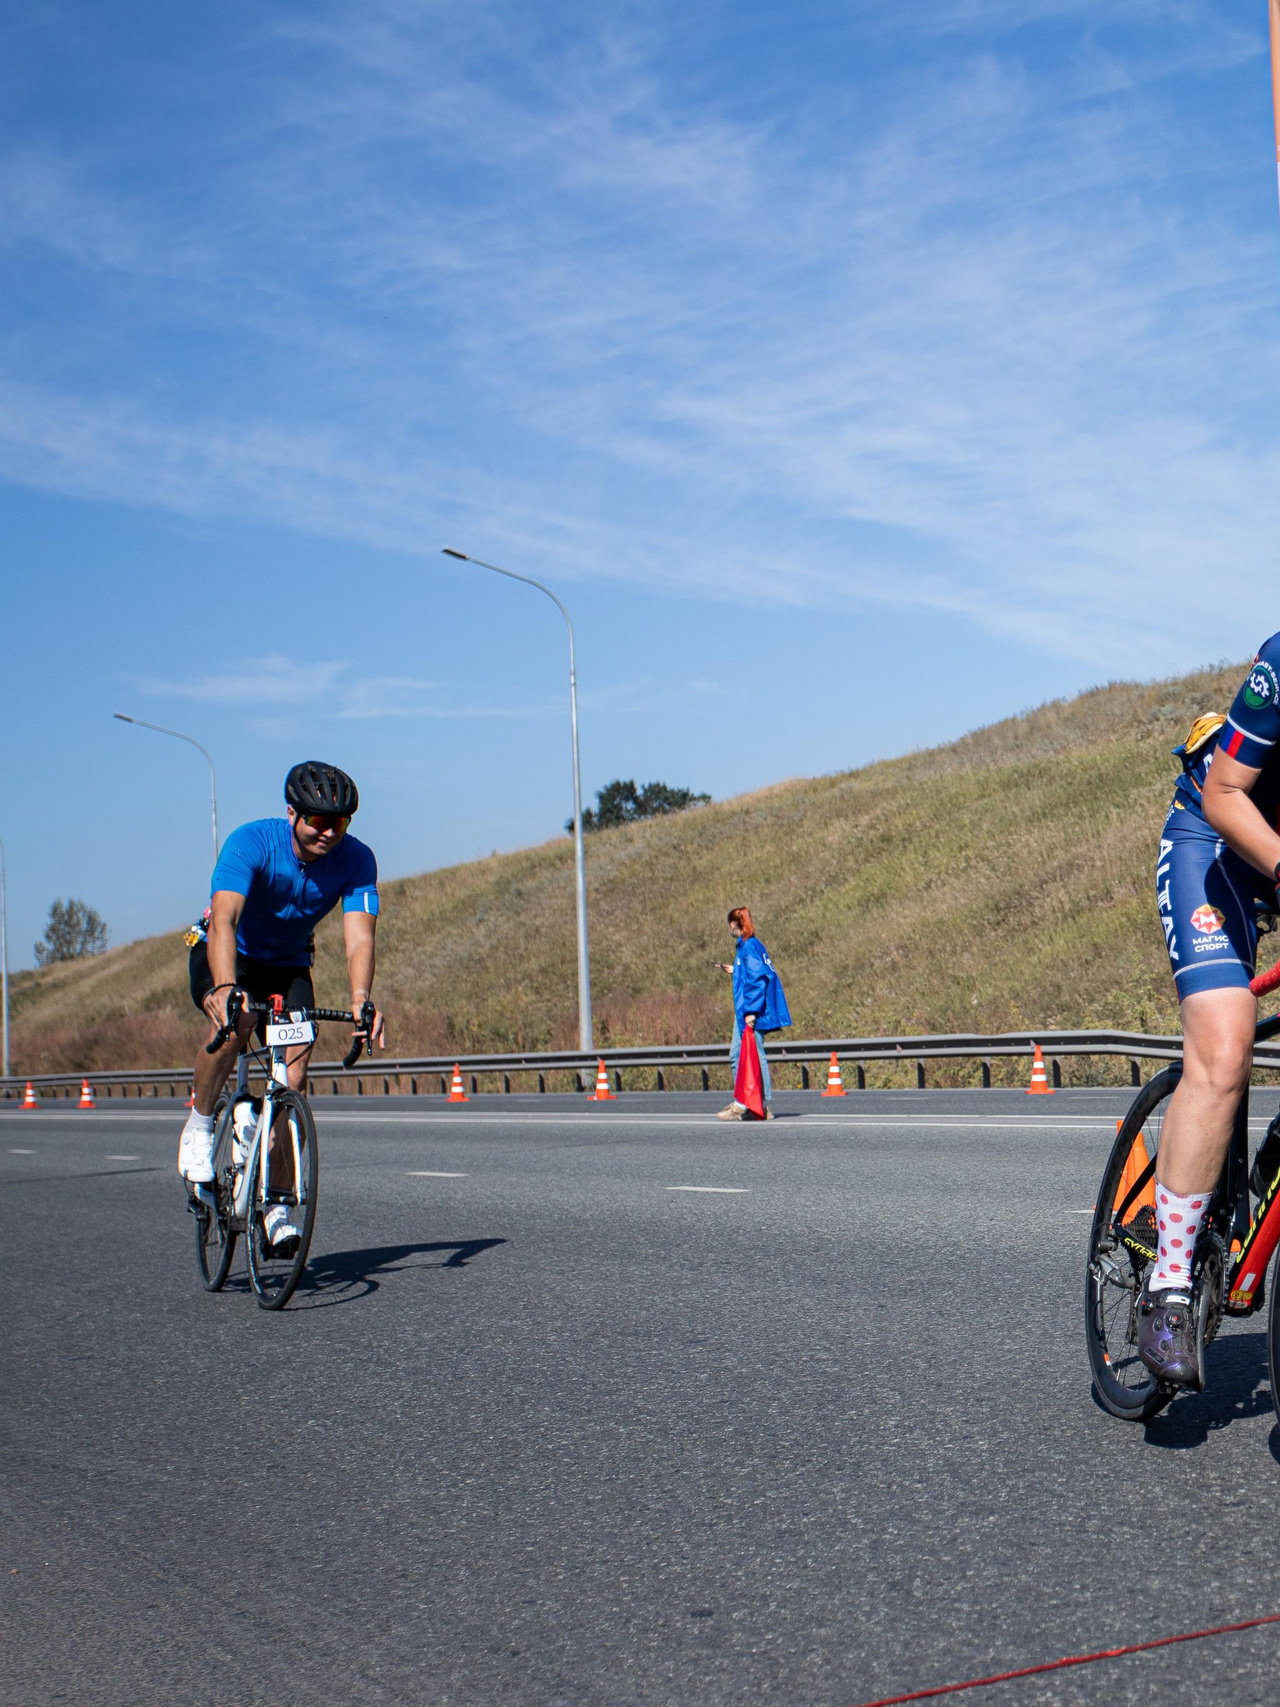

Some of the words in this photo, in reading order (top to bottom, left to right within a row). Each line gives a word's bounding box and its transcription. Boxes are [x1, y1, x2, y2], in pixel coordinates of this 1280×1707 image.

[1157, 838, 1179, 961] ALTAY
[1192, 935, 1229, 945] МАГИС
[1194, 942, 1229, 953] СПОРТ
[278, 1026, 304, 1041] 025
